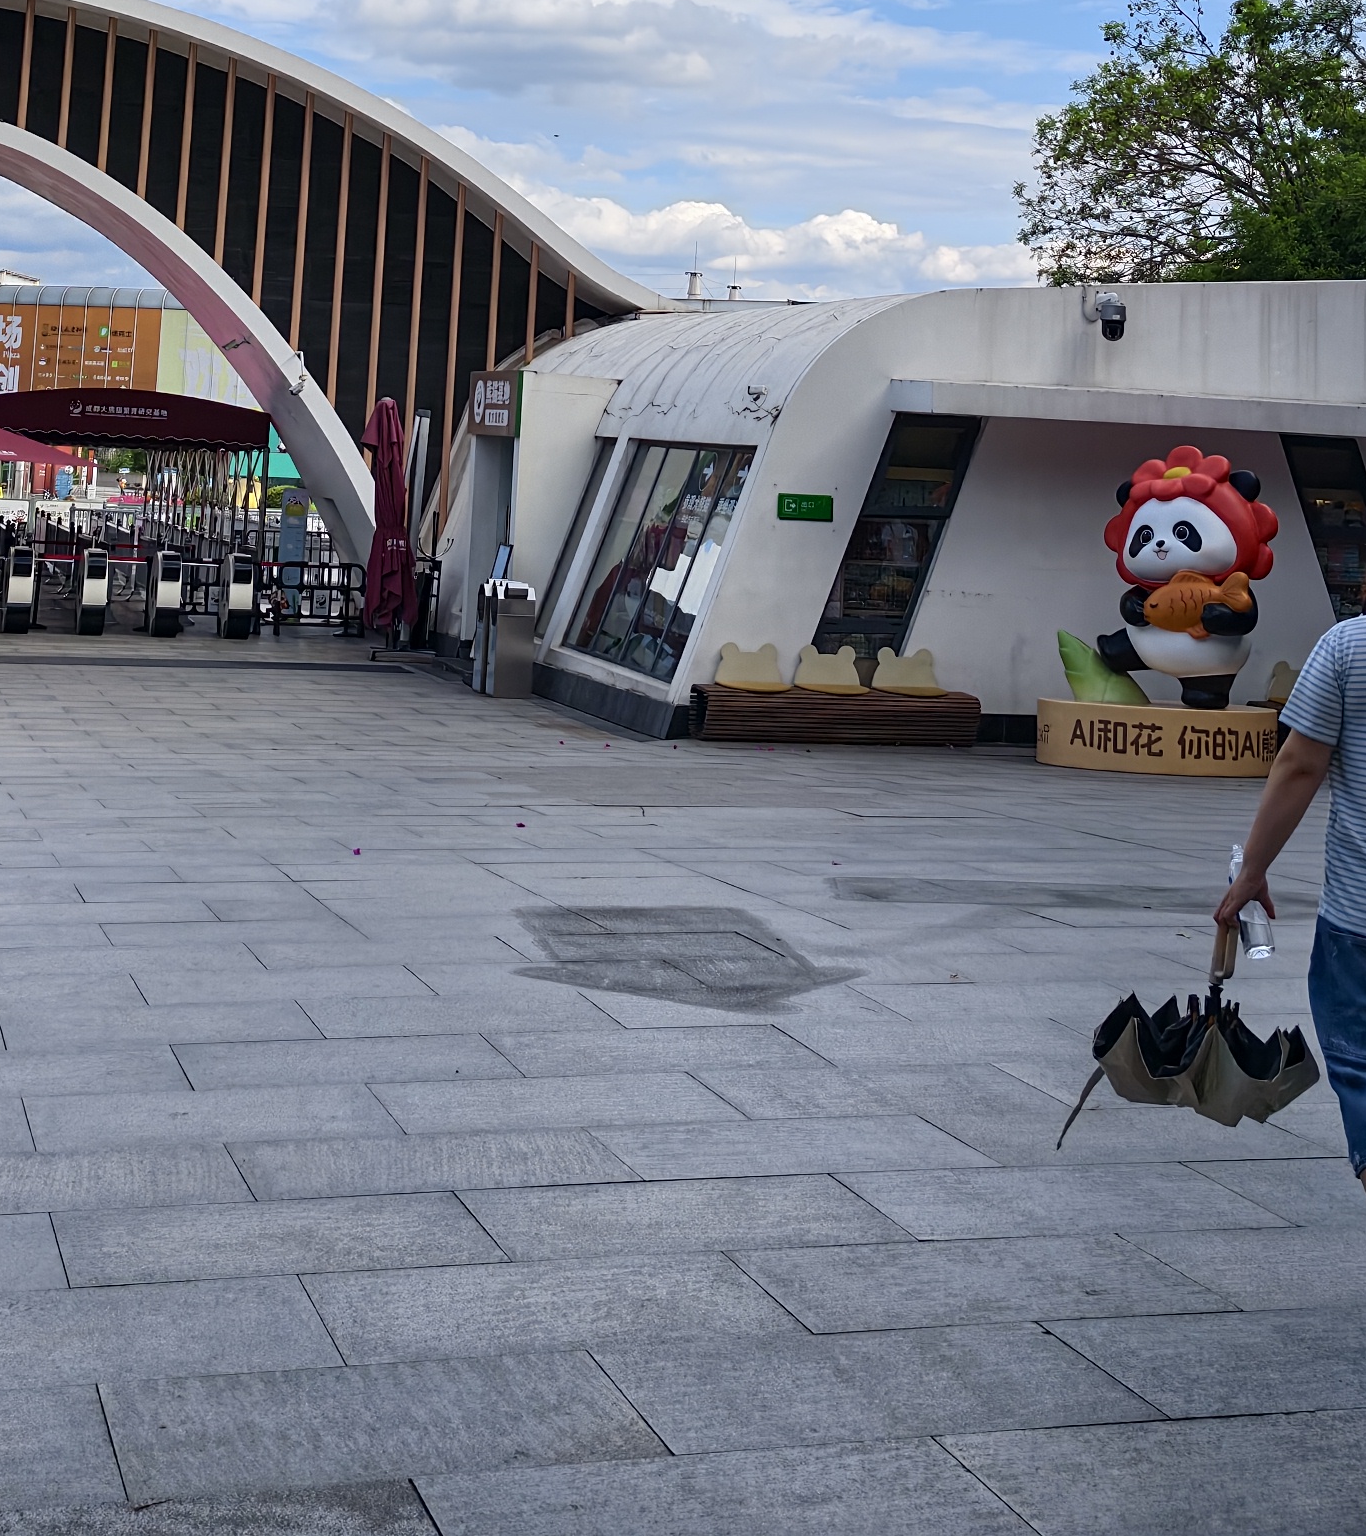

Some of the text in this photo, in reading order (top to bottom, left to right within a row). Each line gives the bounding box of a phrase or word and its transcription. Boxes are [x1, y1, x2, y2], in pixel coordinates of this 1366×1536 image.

[485, 380, 511, 405] 熊猫基地
[1069, 718, 1164, 757] AI和花
